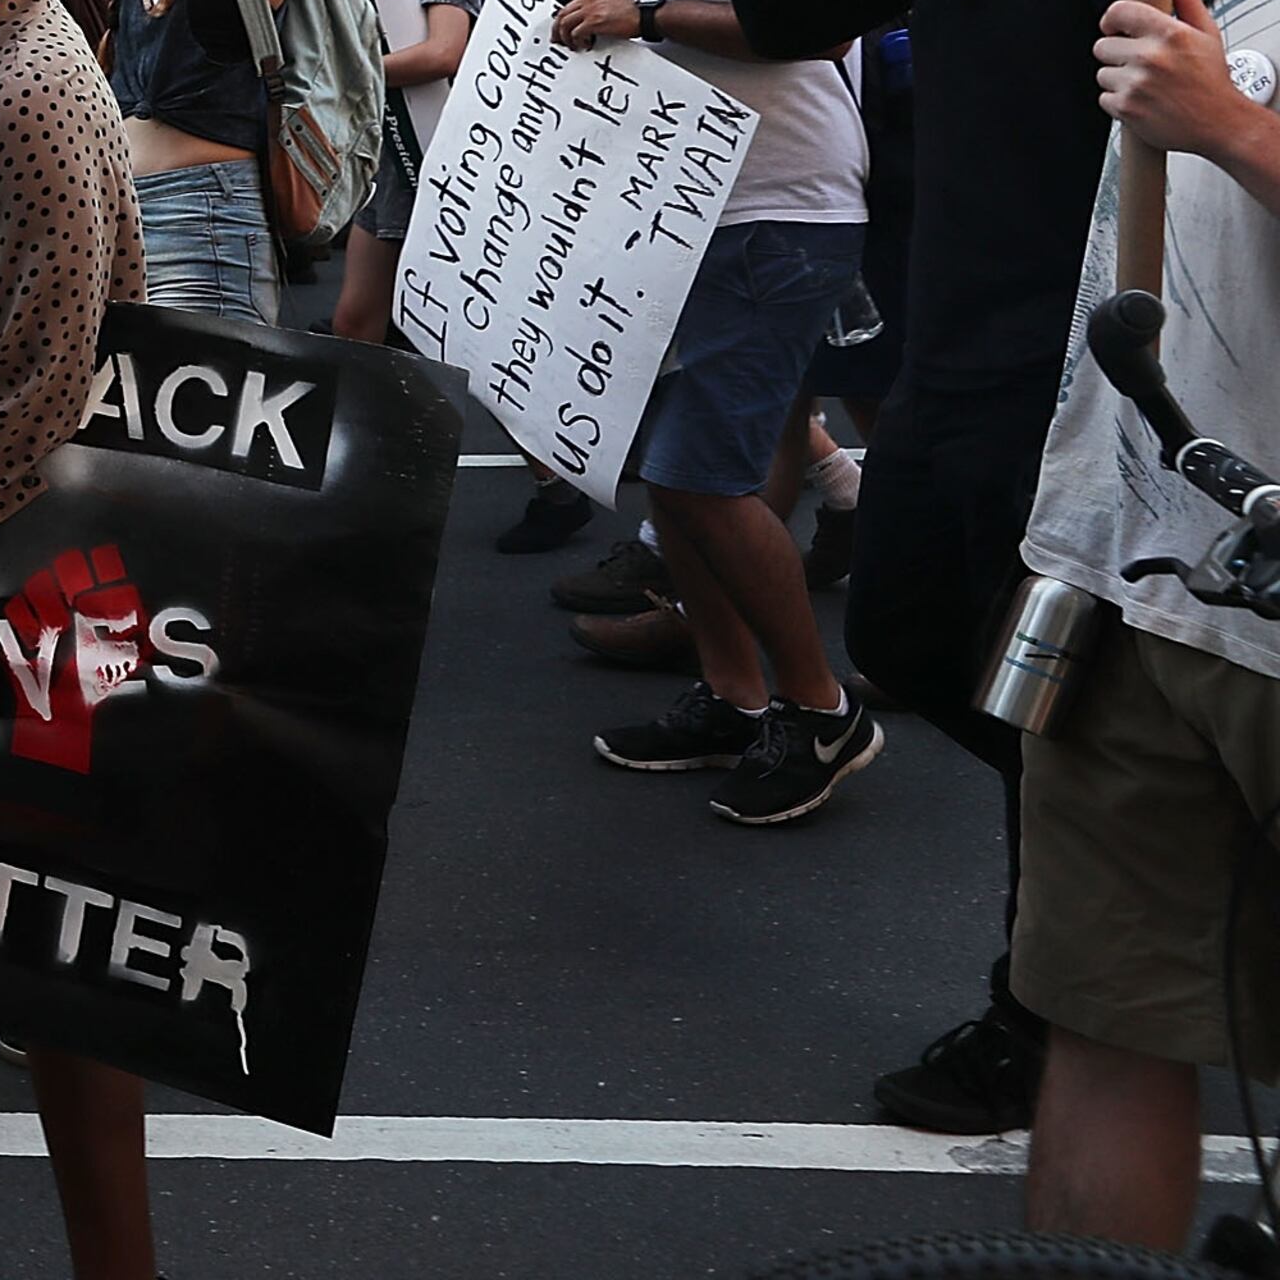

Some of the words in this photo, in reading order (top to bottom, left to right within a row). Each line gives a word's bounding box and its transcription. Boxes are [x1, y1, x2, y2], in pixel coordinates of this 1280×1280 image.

[385, 114, 418, 187] Presiden
[619, 90, 687, 212] MARK
[648, 90, 747, 251] TWAIN
[398, 269, 449, 361] If
[430, 125, 504, 266] voting
[462, 167, 534, 332] change
[488, 316, 555, 412] they
[538, 142, 608, 310] wouldn't
[573, 53, 643, 127] let
[77, 350, 316, 472] ACK
[564, 322, 614, 398] do
[550, 400, 602, 477] us
